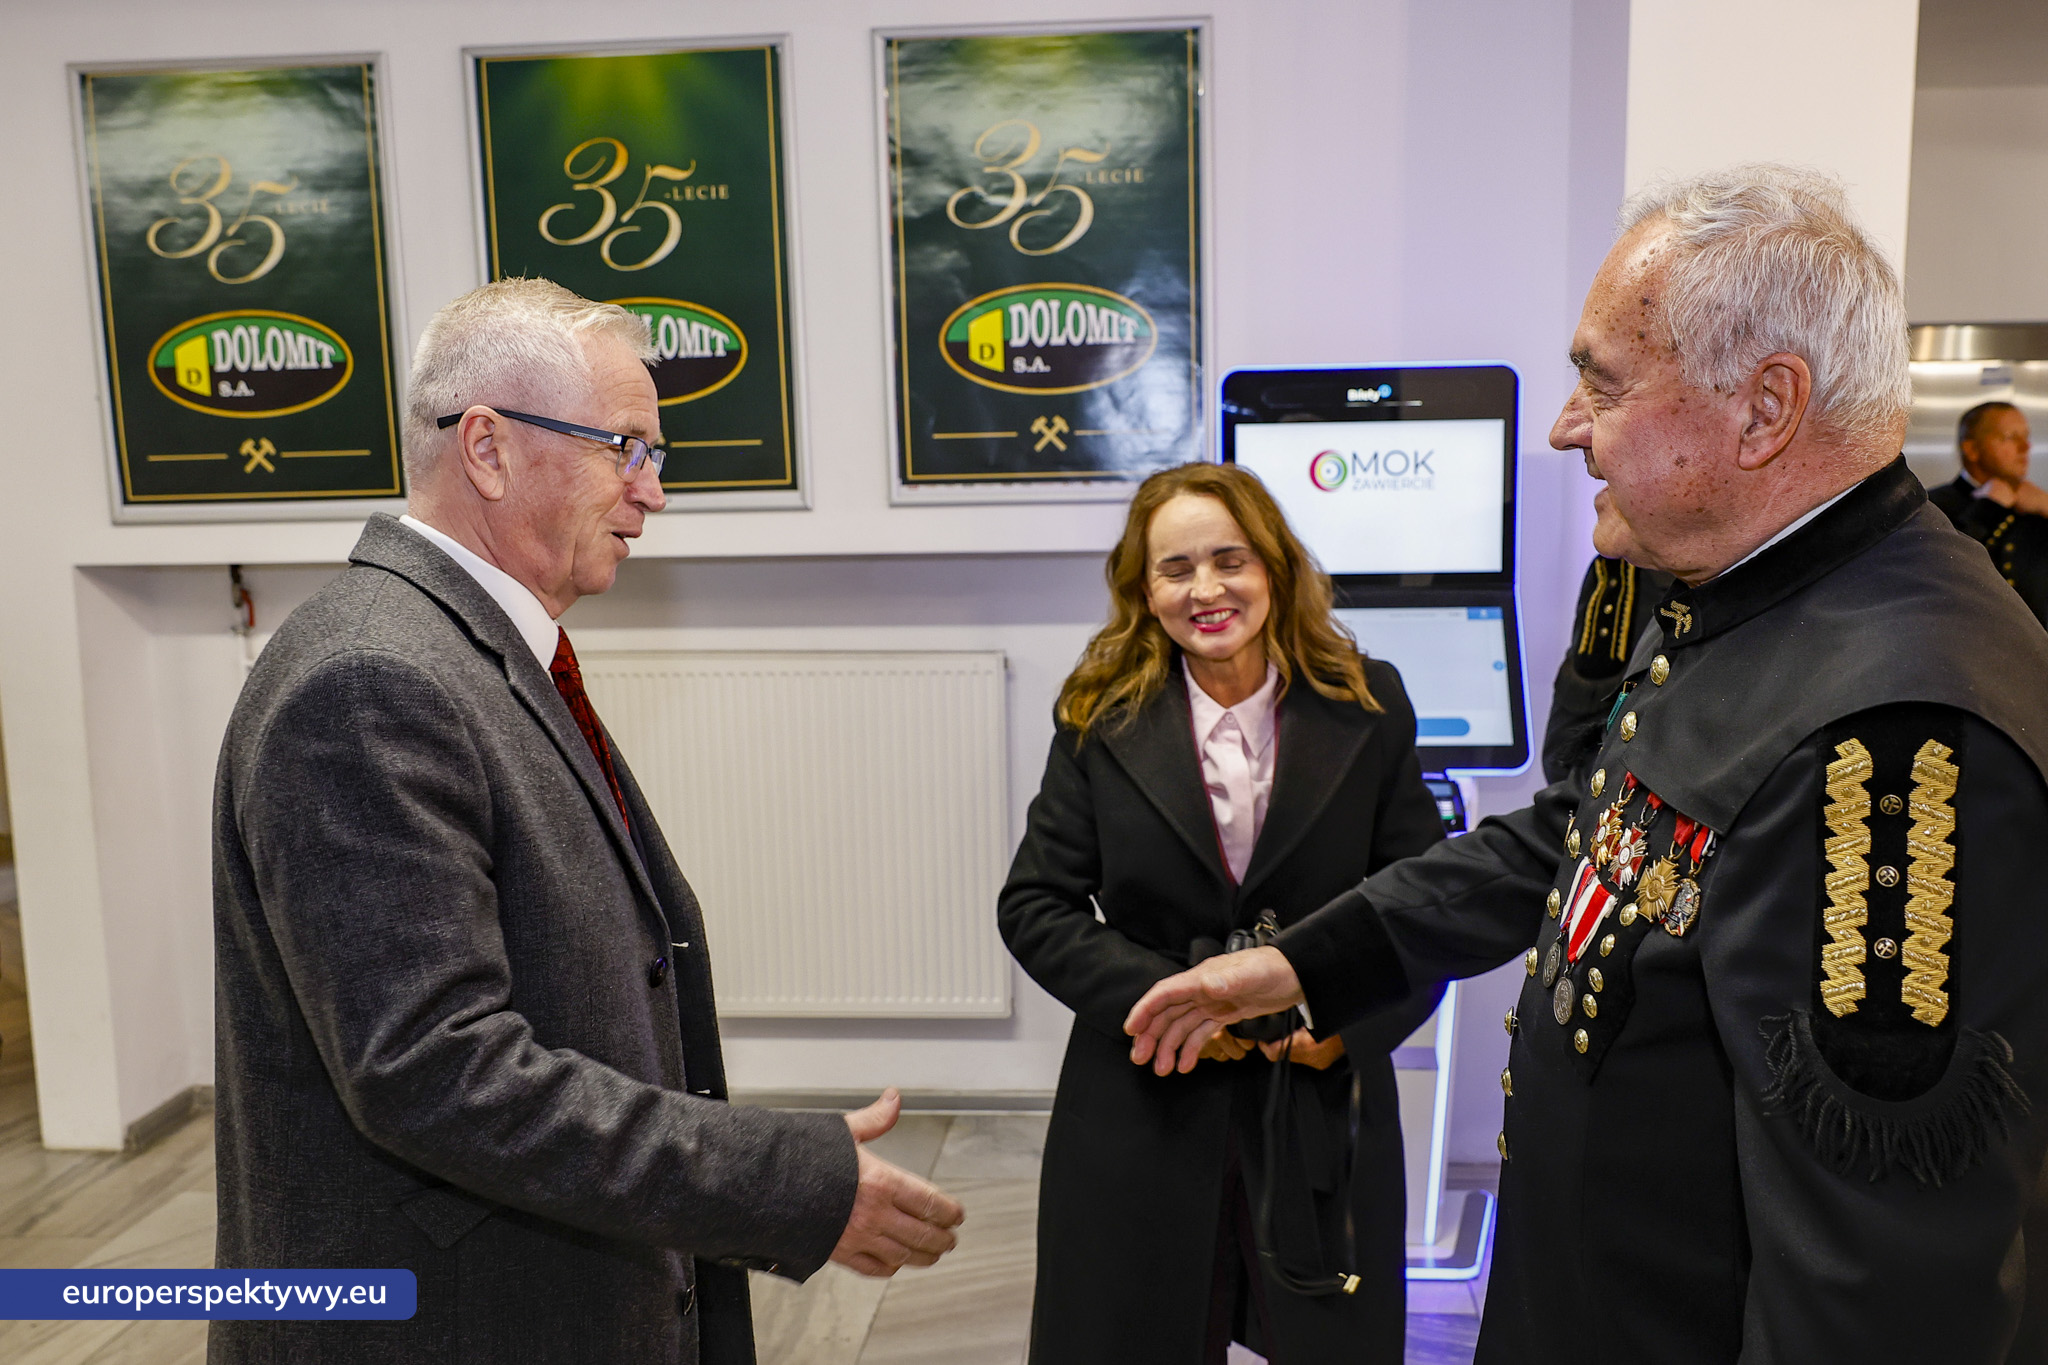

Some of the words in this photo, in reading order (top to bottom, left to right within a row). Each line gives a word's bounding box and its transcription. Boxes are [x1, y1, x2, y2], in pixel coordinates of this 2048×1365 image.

[1008, 298, 1139, 348] DOLOMIT
[211, 325, 336, 373] DOLOMIT
[979, 343, 995, 361] D
[1012, 355, 1051, 374] S.A.
[186, 368, 203, 386] D
[217, 380, 256, 398] S.A.
[1351, 450, 1435, 477] MOK
